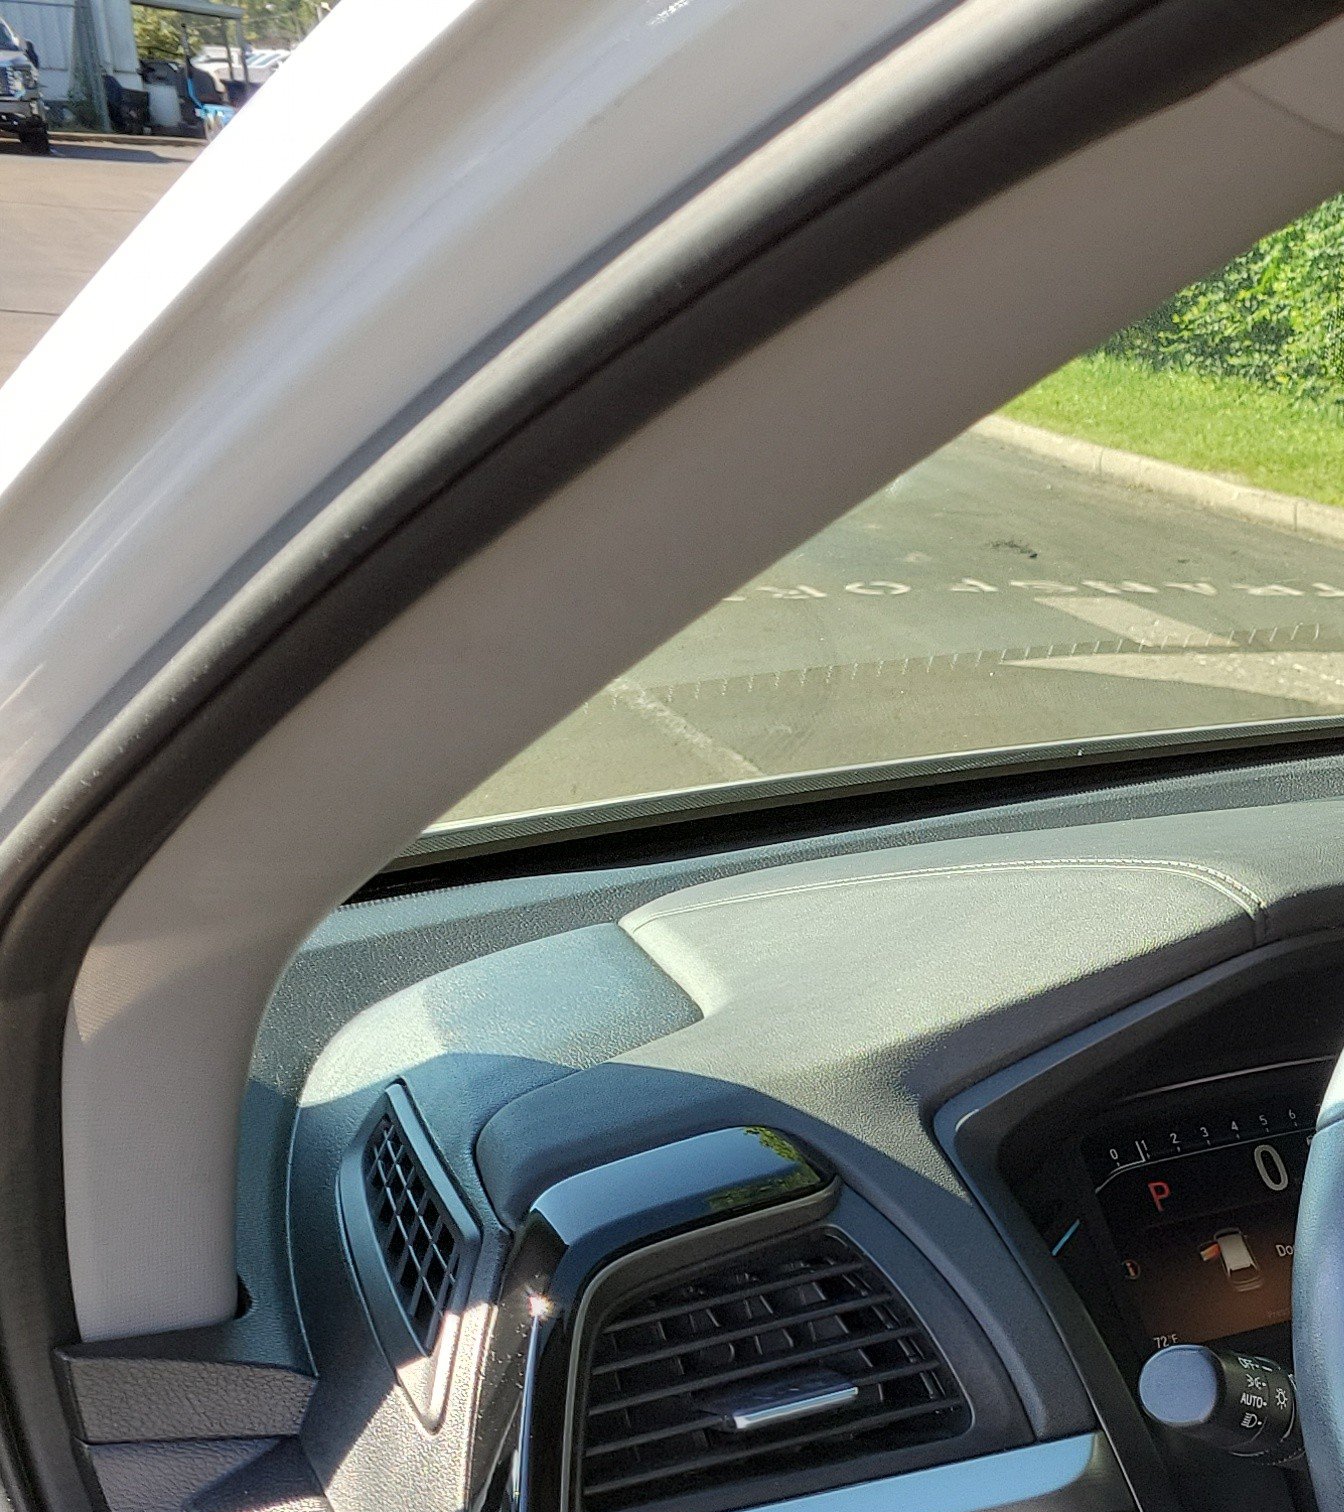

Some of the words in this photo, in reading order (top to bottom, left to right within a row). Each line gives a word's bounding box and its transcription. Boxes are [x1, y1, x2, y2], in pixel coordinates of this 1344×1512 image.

[1288, 1108, 1296, 1120] 6
[1231, 1120, 1239, 1132] 4
[1259, 1115, 1268, 1126] 5
[1169, 1133, 1181, 1144] 2
[1200, 1127, 1209, 1138] 3
[1254, 1144, 1289, 1192] 0
[1147, 1181, 1171, 1212] P
[1275, 1244, 1295, 1257] Do
[1240, 1392, 1263, 1408] AUTO
